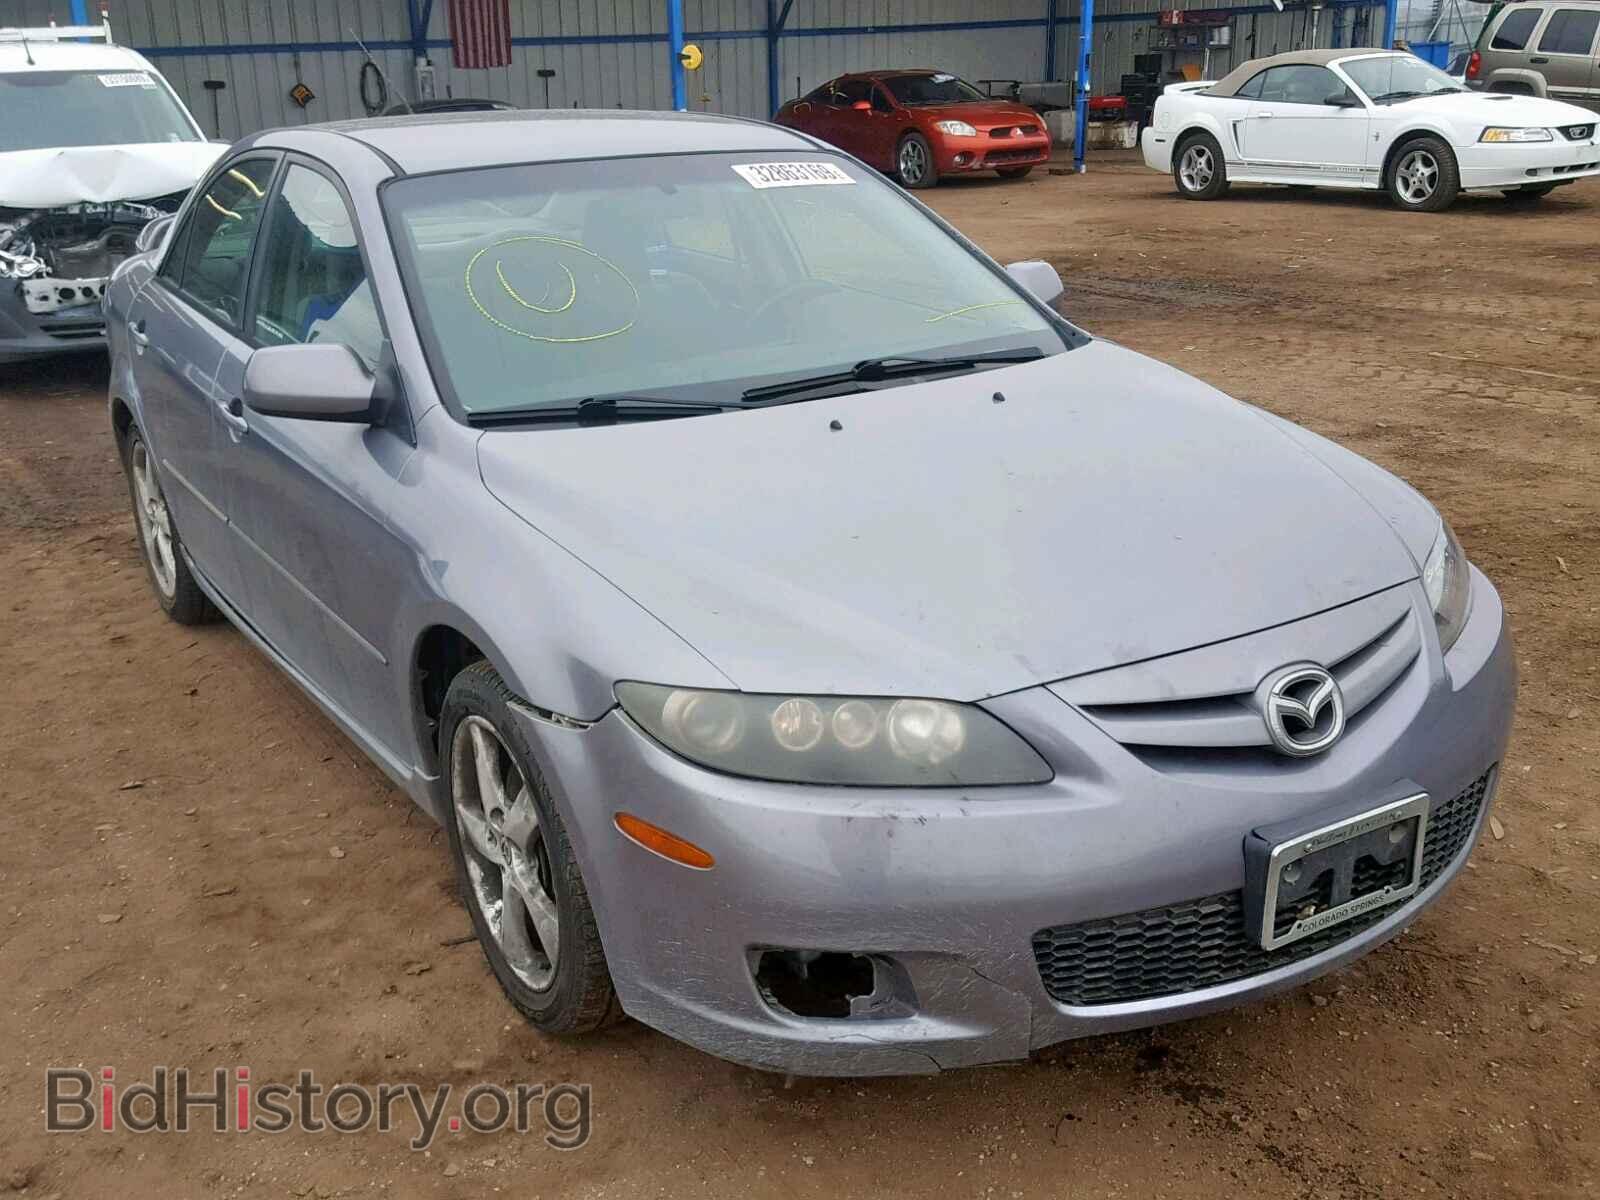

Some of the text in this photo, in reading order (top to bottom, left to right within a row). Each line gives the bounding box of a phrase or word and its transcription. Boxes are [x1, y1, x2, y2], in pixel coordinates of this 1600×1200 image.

[749, 164, 837, 182] 32863169
[1302, 895, 1385, 933] COLORADO SPRINGS
